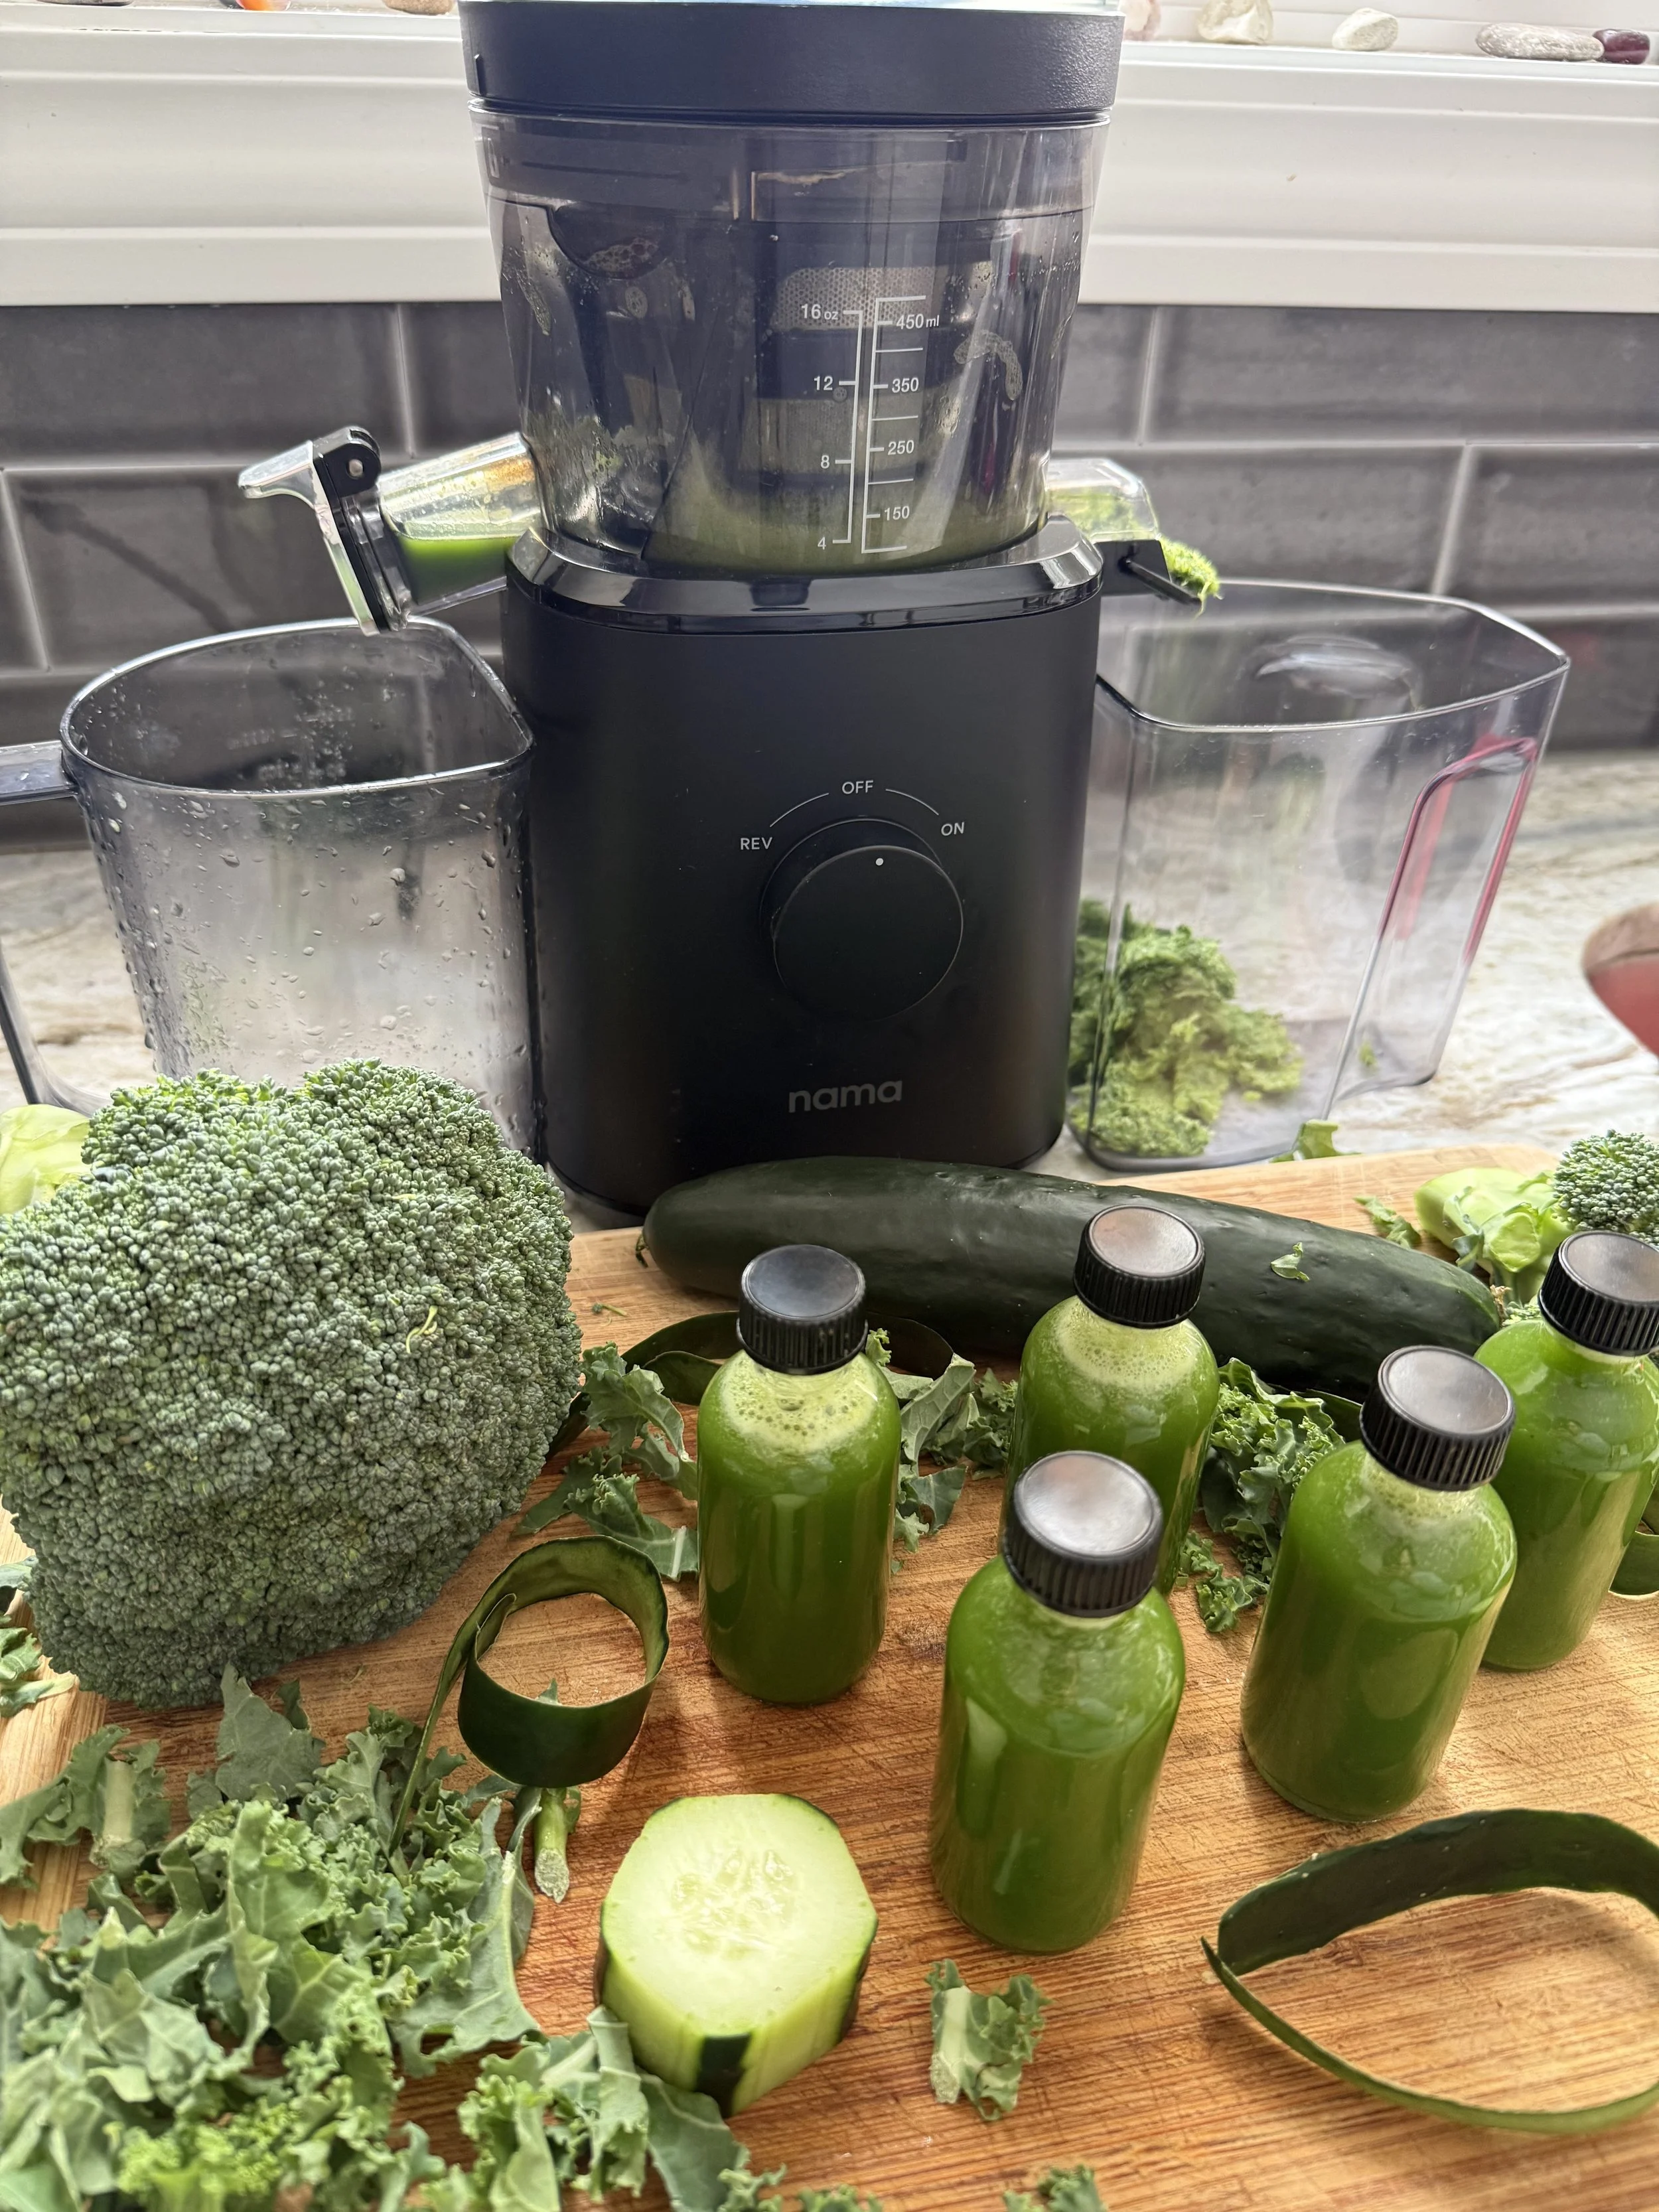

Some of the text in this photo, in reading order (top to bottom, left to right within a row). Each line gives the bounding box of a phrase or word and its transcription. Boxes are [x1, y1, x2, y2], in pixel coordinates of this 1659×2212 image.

[814, 376, 833, 391] 12
[891, 378, 919, 393] 350
[888, 439, 914, 455] 250
[820, 455, 830, 469] 8
[885, 506, 910, 521] 150
[817, 537, 827, 550] 4
[841, 780, 874, 795] OFF
[940, 822, 965, 836] ON
[740, 837, 772, 850] REV
[788, 1080, 902, 1113] nama
